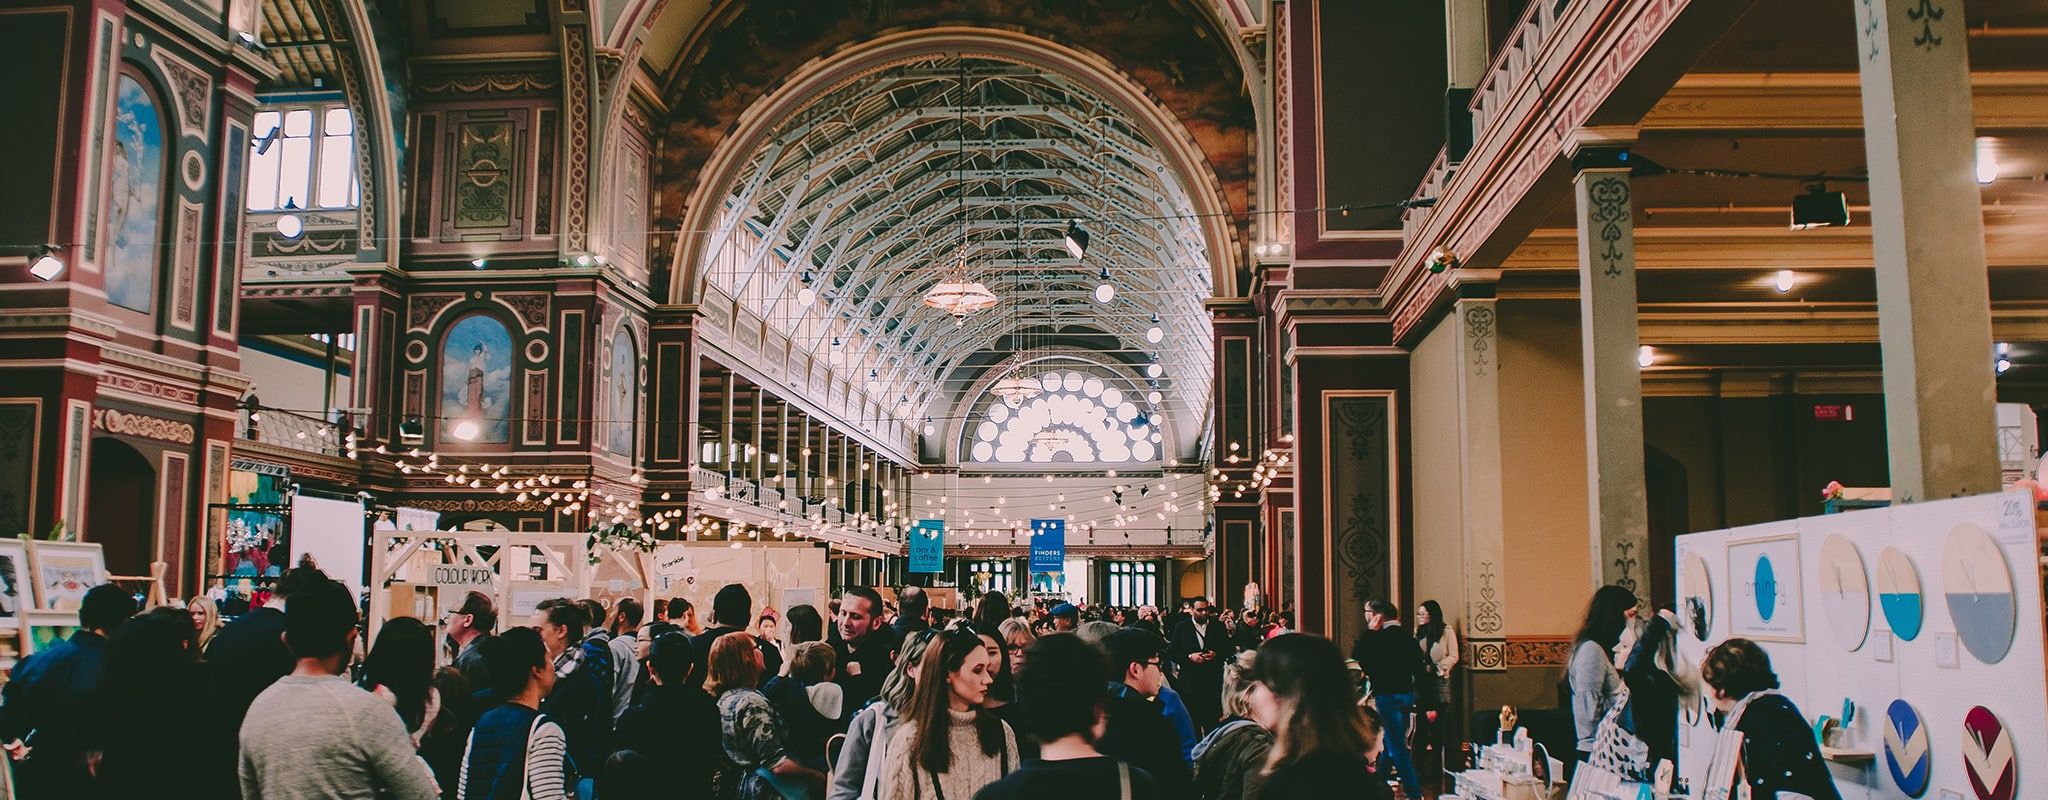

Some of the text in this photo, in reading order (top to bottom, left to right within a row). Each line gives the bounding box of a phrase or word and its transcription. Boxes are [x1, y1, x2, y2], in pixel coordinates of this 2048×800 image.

[662, 555, 684, 569] frankie
[435, 567, 493, 585] COLOUR WORK
